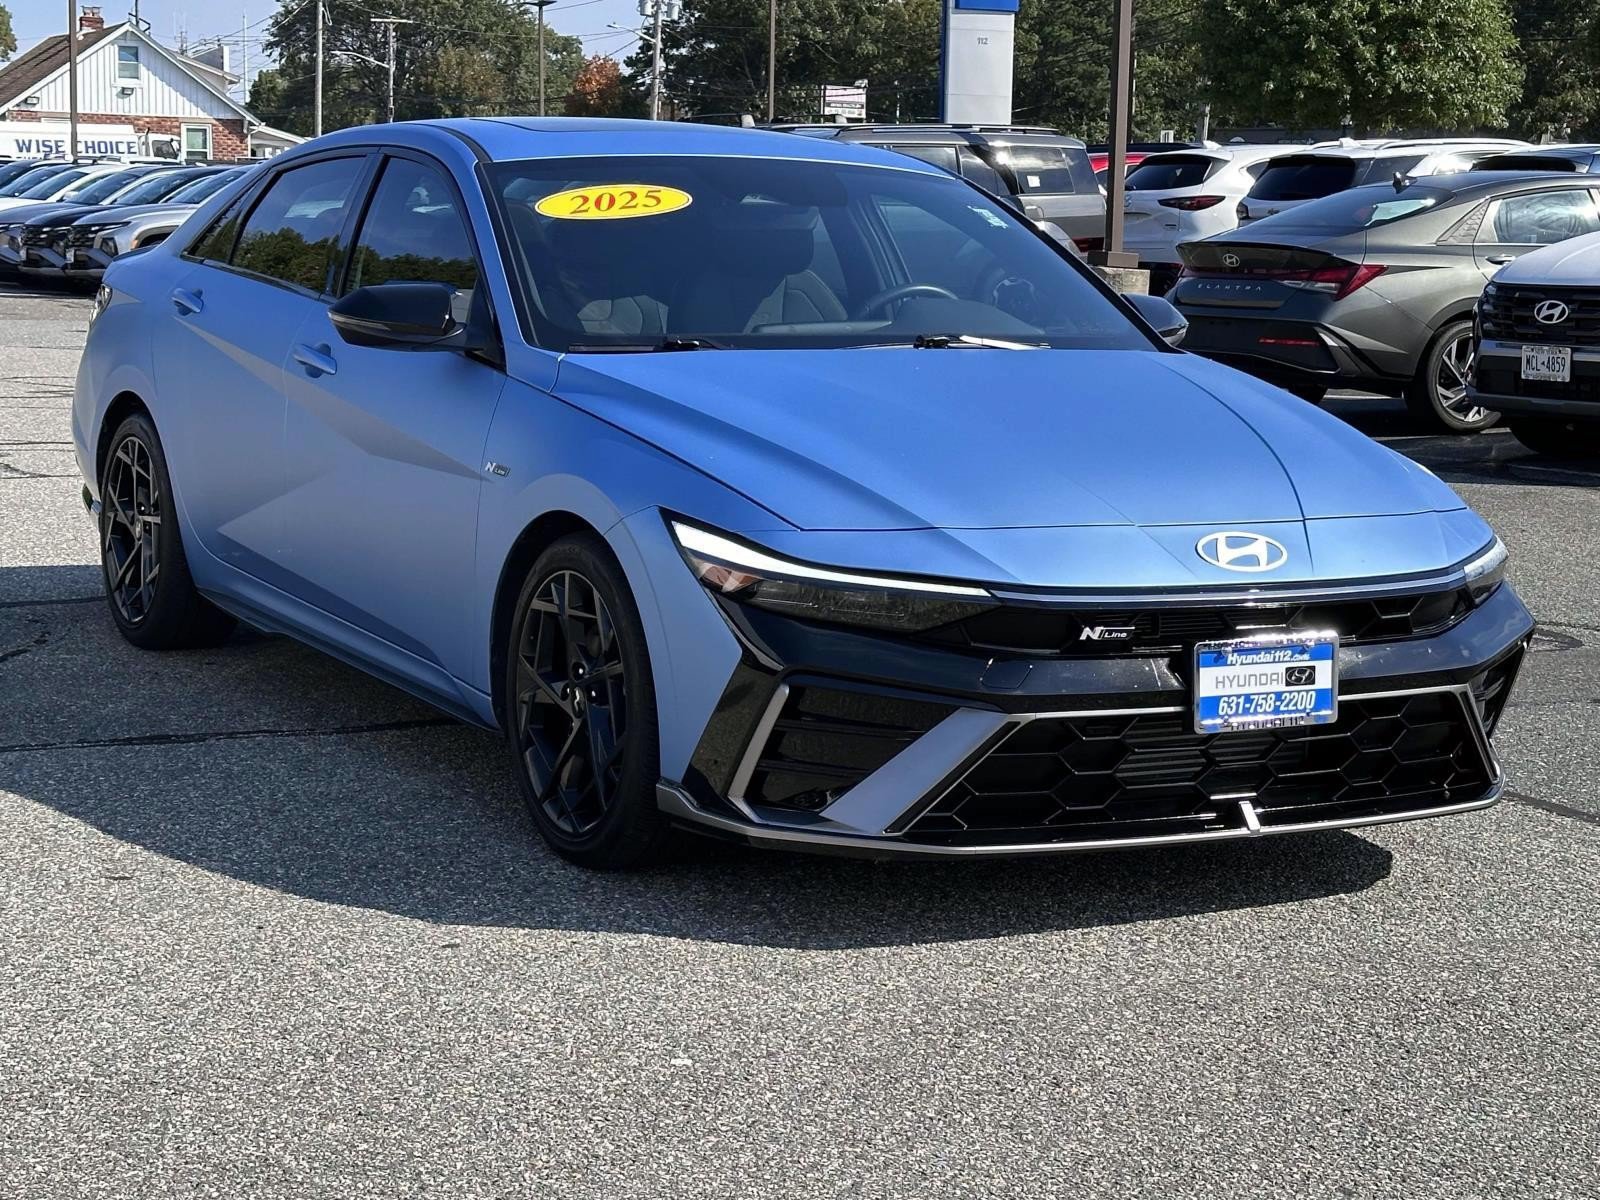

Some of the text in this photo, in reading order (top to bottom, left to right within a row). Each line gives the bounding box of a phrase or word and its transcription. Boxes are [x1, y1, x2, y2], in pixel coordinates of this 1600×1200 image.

[977, 37, 988, 45] 112
[15, 138, 138, 155] WISE CHOICE
[569, 189, 662, 215] 2025
[1197, 283, 1262, 292] ELANTRA
[1079, 626, 1103, 640] N
[1215, 671, 1284, 689] HYUNDAI
[1218, 691, 1316, 716] 631-758-2200
